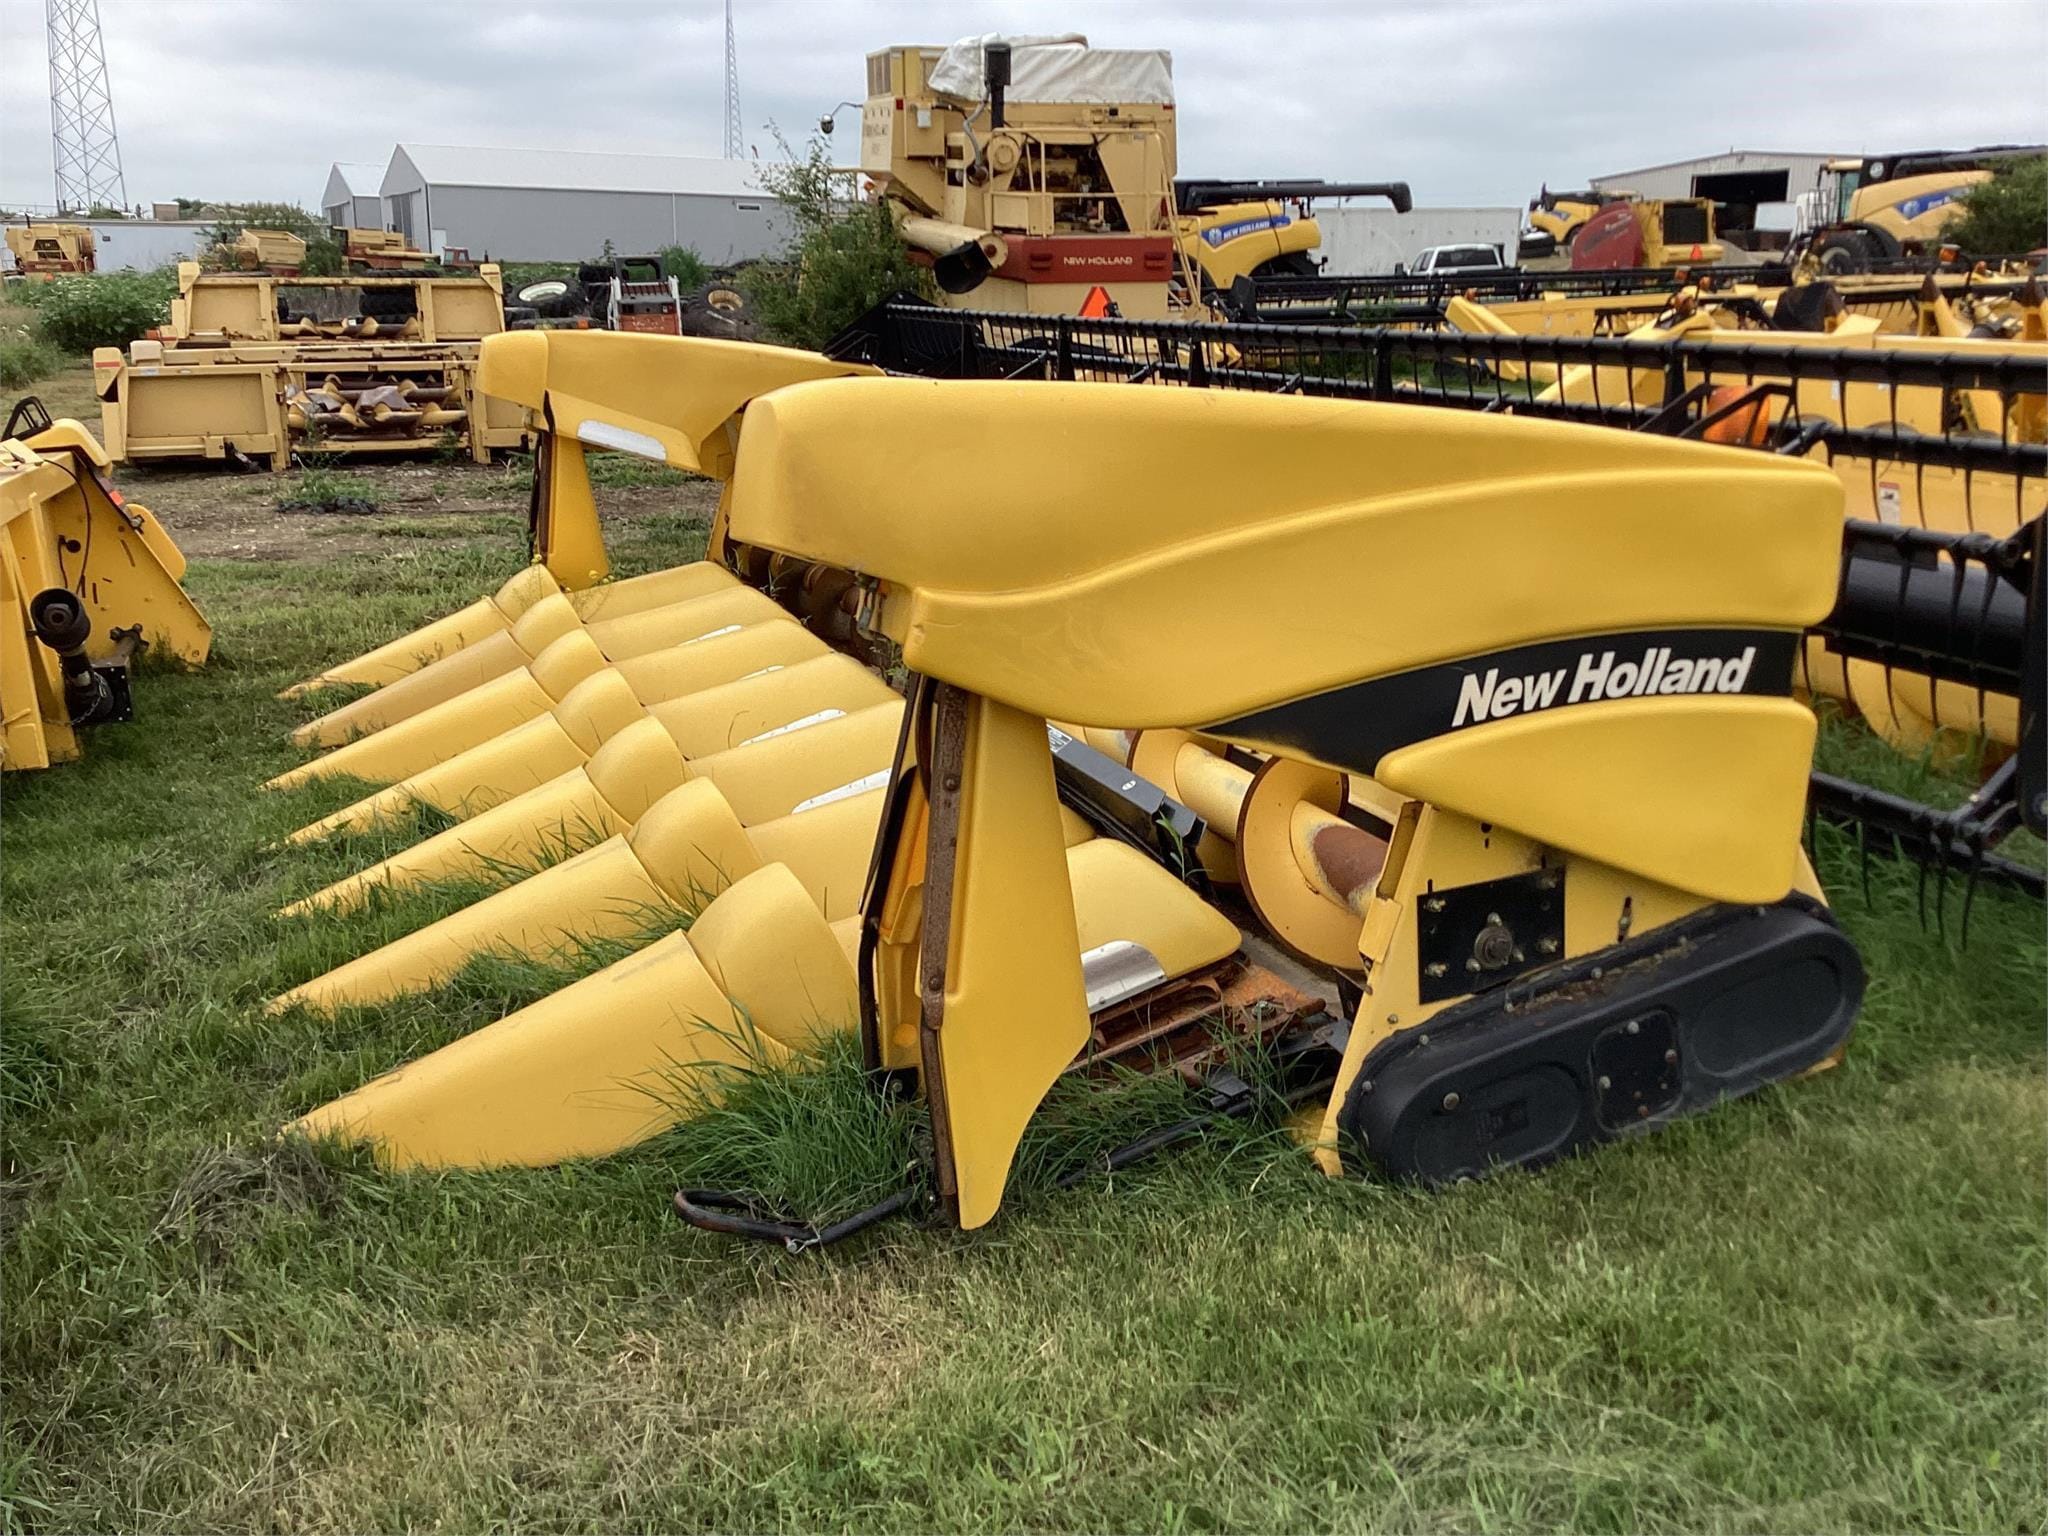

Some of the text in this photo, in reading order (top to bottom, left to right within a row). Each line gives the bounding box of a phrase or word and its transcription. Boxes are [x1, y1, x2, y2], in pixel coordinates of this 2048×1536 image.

[1223, 227, 1239, 241] NEW
[1239, 220, 1270, 234] HOLLAND
[1063, 256, 1133, 265] NEW HOLLAND
[1451, 647, 1757, 727] New Holland
